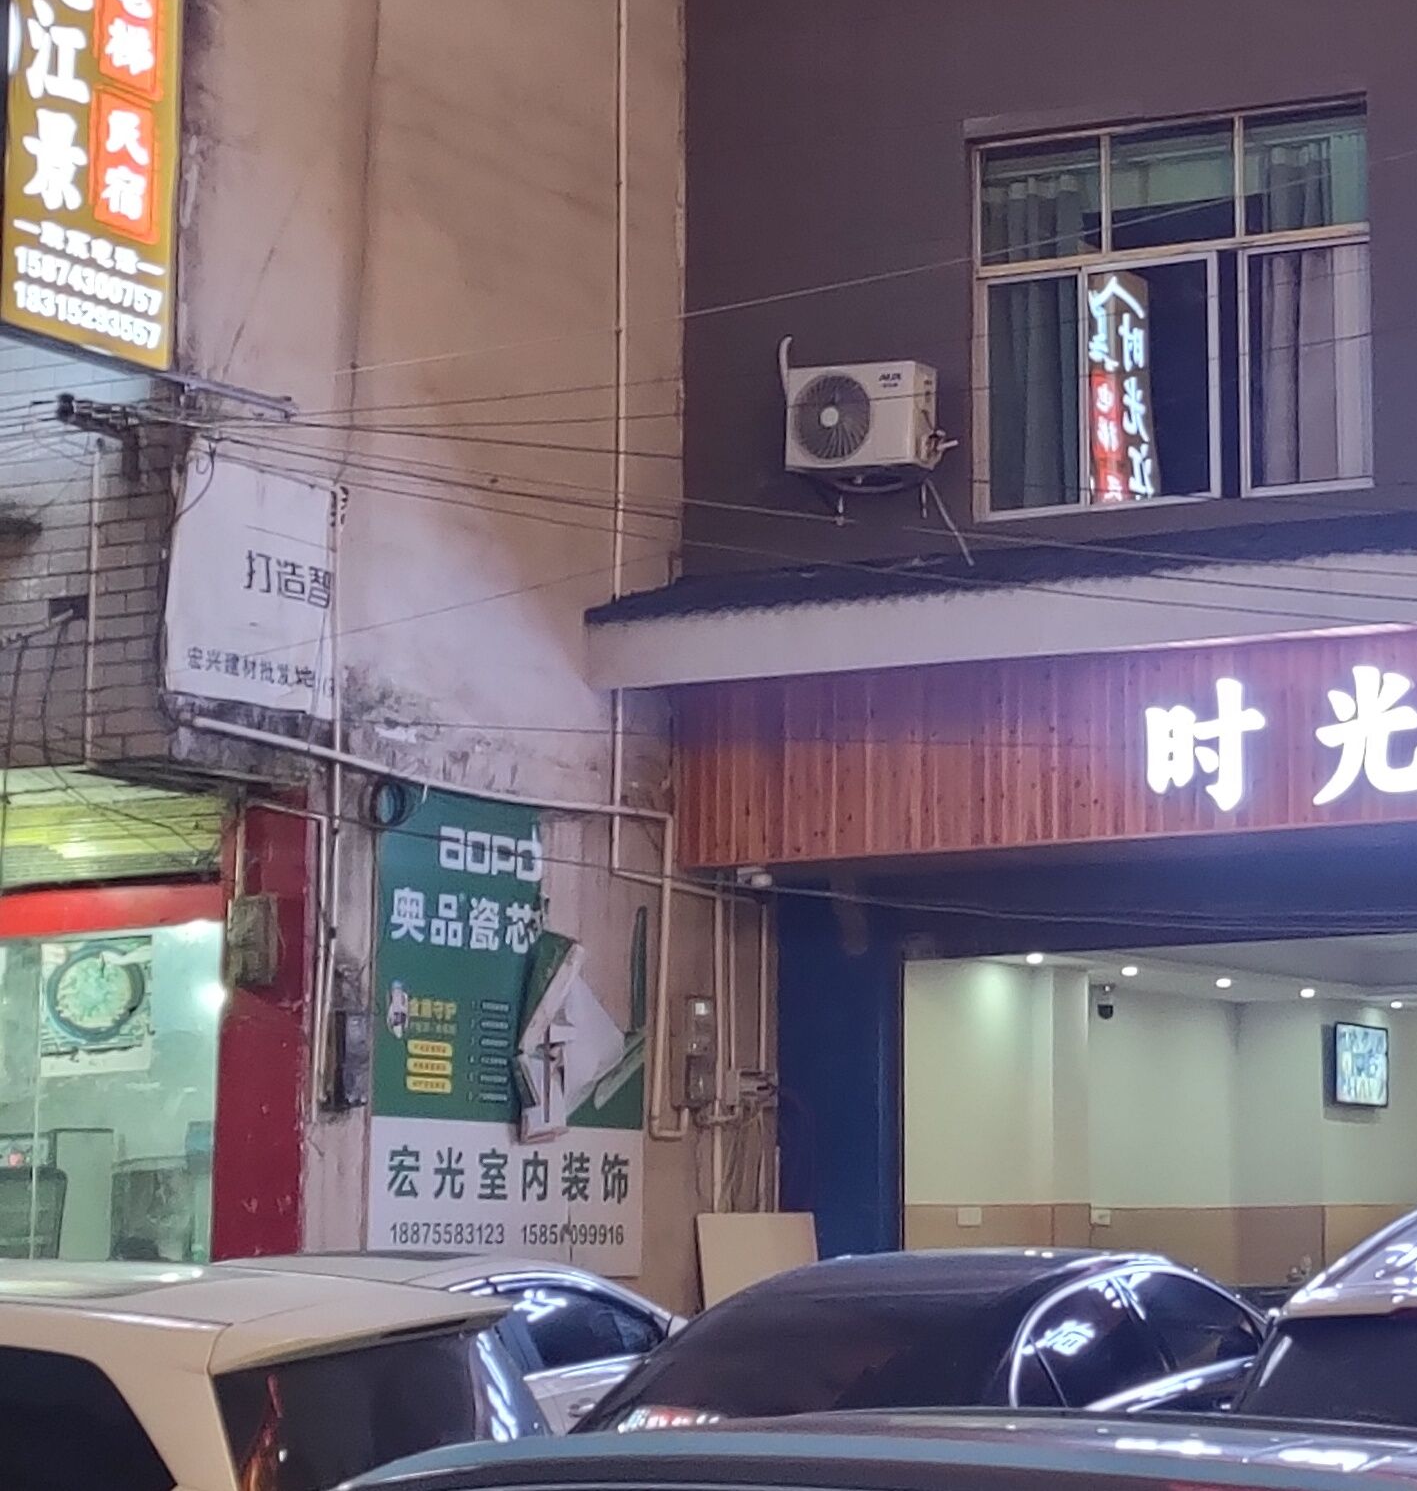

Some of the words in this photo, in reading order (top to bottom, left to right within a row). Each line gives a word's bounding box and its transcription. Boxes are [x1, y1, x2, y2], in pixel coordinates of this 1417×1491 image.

[387, 1145, 630, 1205] 宏光室内装饰
[389, 1221, 505, 1245] 18875583123
